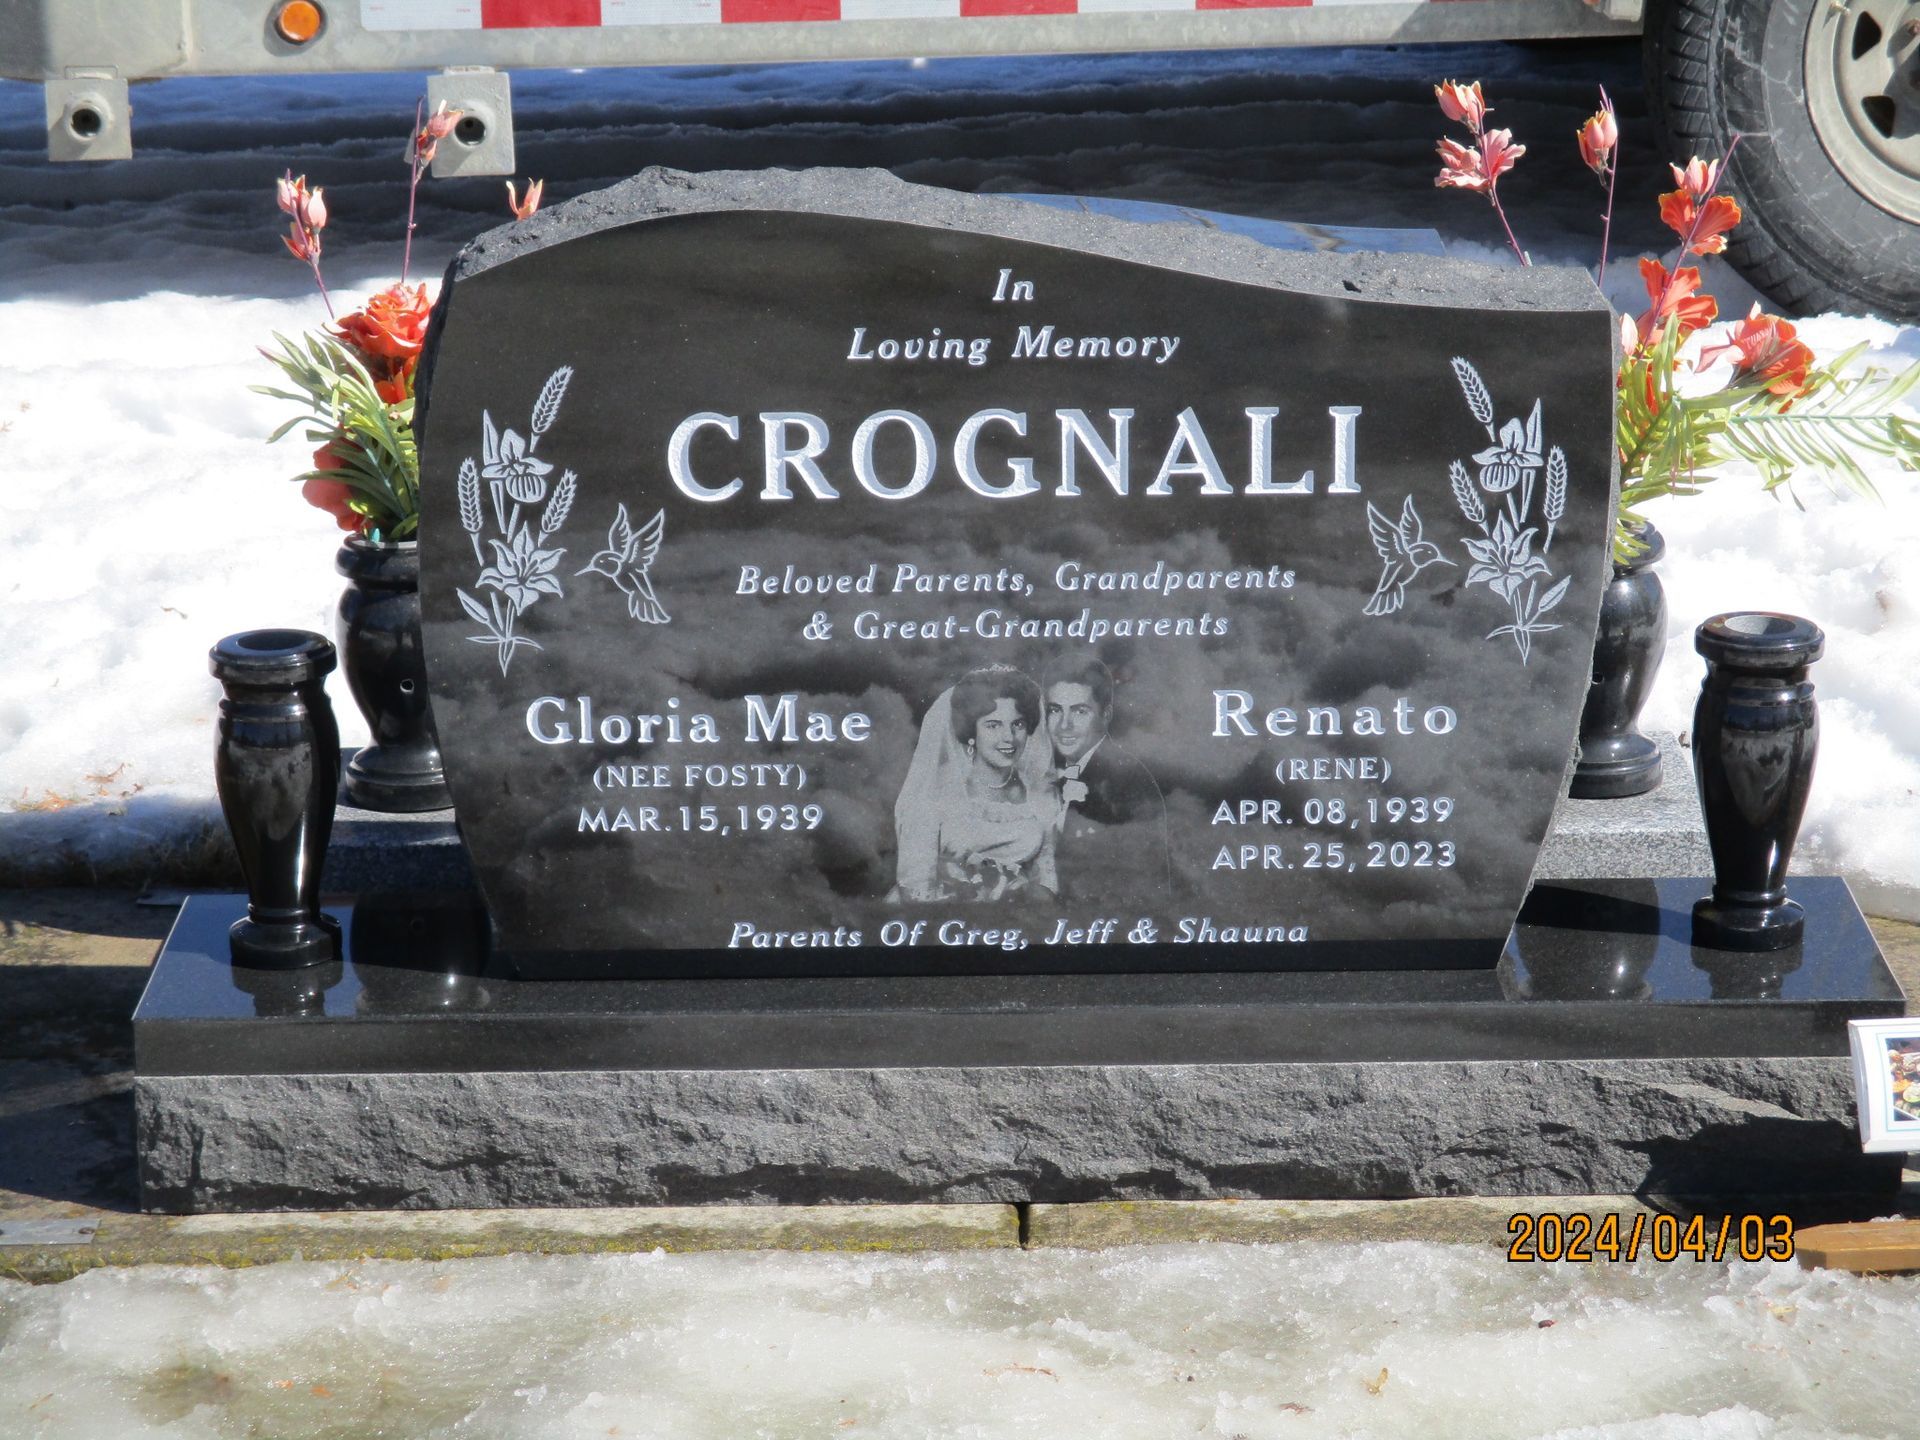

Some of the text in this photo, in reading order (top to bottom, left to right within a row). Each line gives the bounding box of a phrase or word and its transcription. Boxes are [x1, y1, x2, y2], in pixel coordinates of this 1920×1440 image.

[991, 268, 1034, 302] In
[846, 325, 1181, 367] Loving Memory
[666, 405, 1363, 501] CROGNALI
[735, 560, 1296, 597] Beloved Parents, Grandparents
[802, 608, 1228, 644] & Great-Grandparents
[525, 694, 871, 745] Gloria Mae
[1211, 689, 1457, 737] Renato
[593, 763, 807, 792] (NEE FOSTY)
[1275, 757, 1392, 785] (RENE)
[577, 806, 671, 833] MAR.
[1210, 799, 1293, 826] APR.
[1211, 844, 1294, 870] APR.
[727, 917, 1308, 951] Parents Of Greg, Jeff & Shauna
